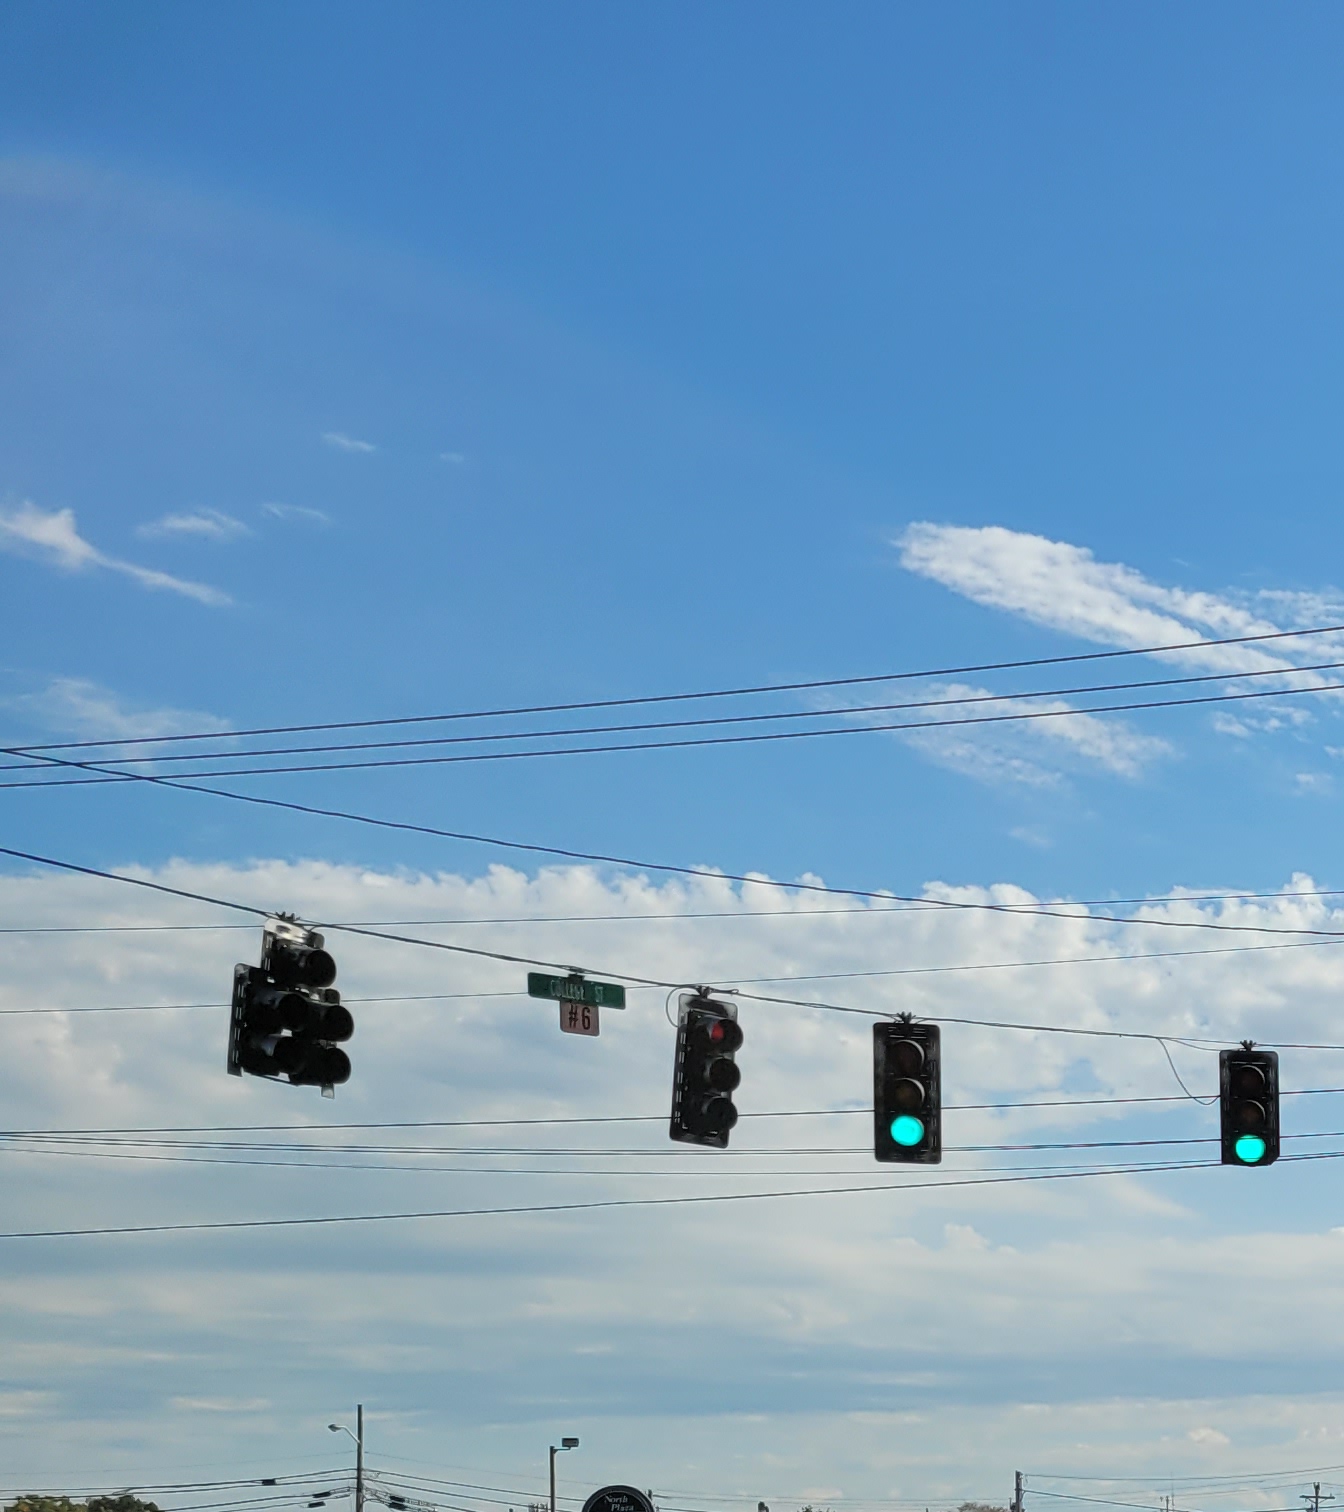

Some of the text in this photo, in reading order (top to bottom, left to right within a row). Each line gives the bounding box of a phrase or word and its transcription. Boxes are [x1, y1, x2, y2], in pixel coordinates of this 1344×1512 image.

[568, 1004, 591, 1030] #6
[604, 1494, 628, 1503] North
[611, 1503, 634, 1511] Plaza
